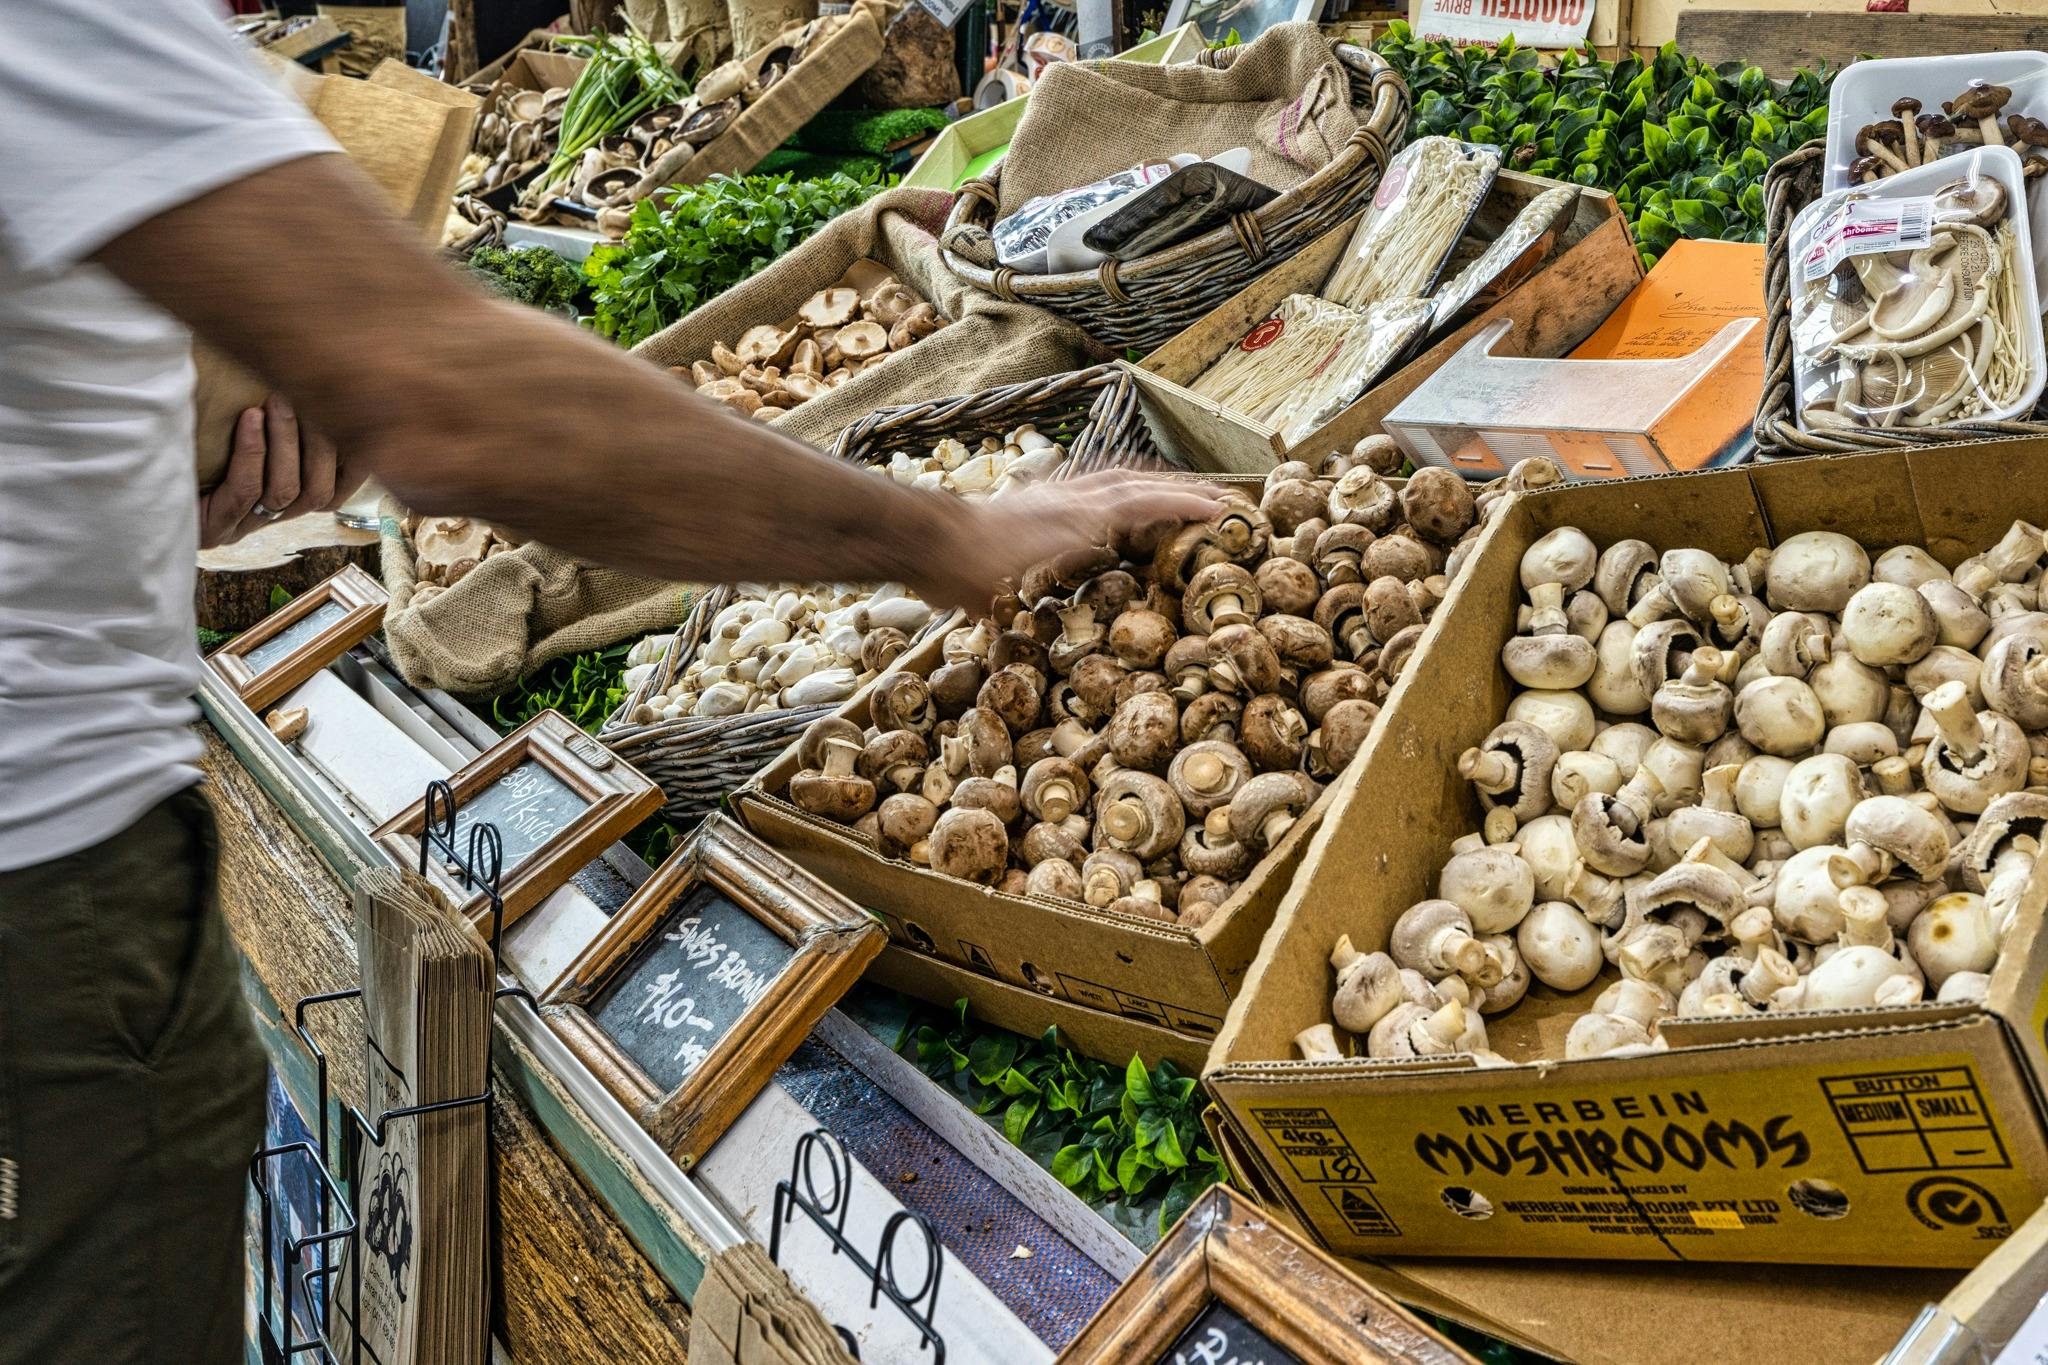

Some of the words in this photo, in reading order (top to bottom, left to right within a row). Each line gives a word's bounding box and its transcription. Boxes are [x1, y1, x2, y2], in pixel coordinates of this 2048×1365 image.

[1852, 1075, 1941, 1094] BUTTON
[1457, 1090, 1710, 1126] MERBEIN
[1840, 1099, 1908, 1124] MEDIUM
[1916, 1094, 1978, 1118] SMALL
[1414, 1114, 1811, 1177] MUSHROOMS
[1562, 1186, 1608, 1196] GROWN
[1625, 1186, 1669, 1196] ACKED
[1503, 1202, 1580, 1214] MERBEIN
[1742, 1200, 1780, 1214] LTD
